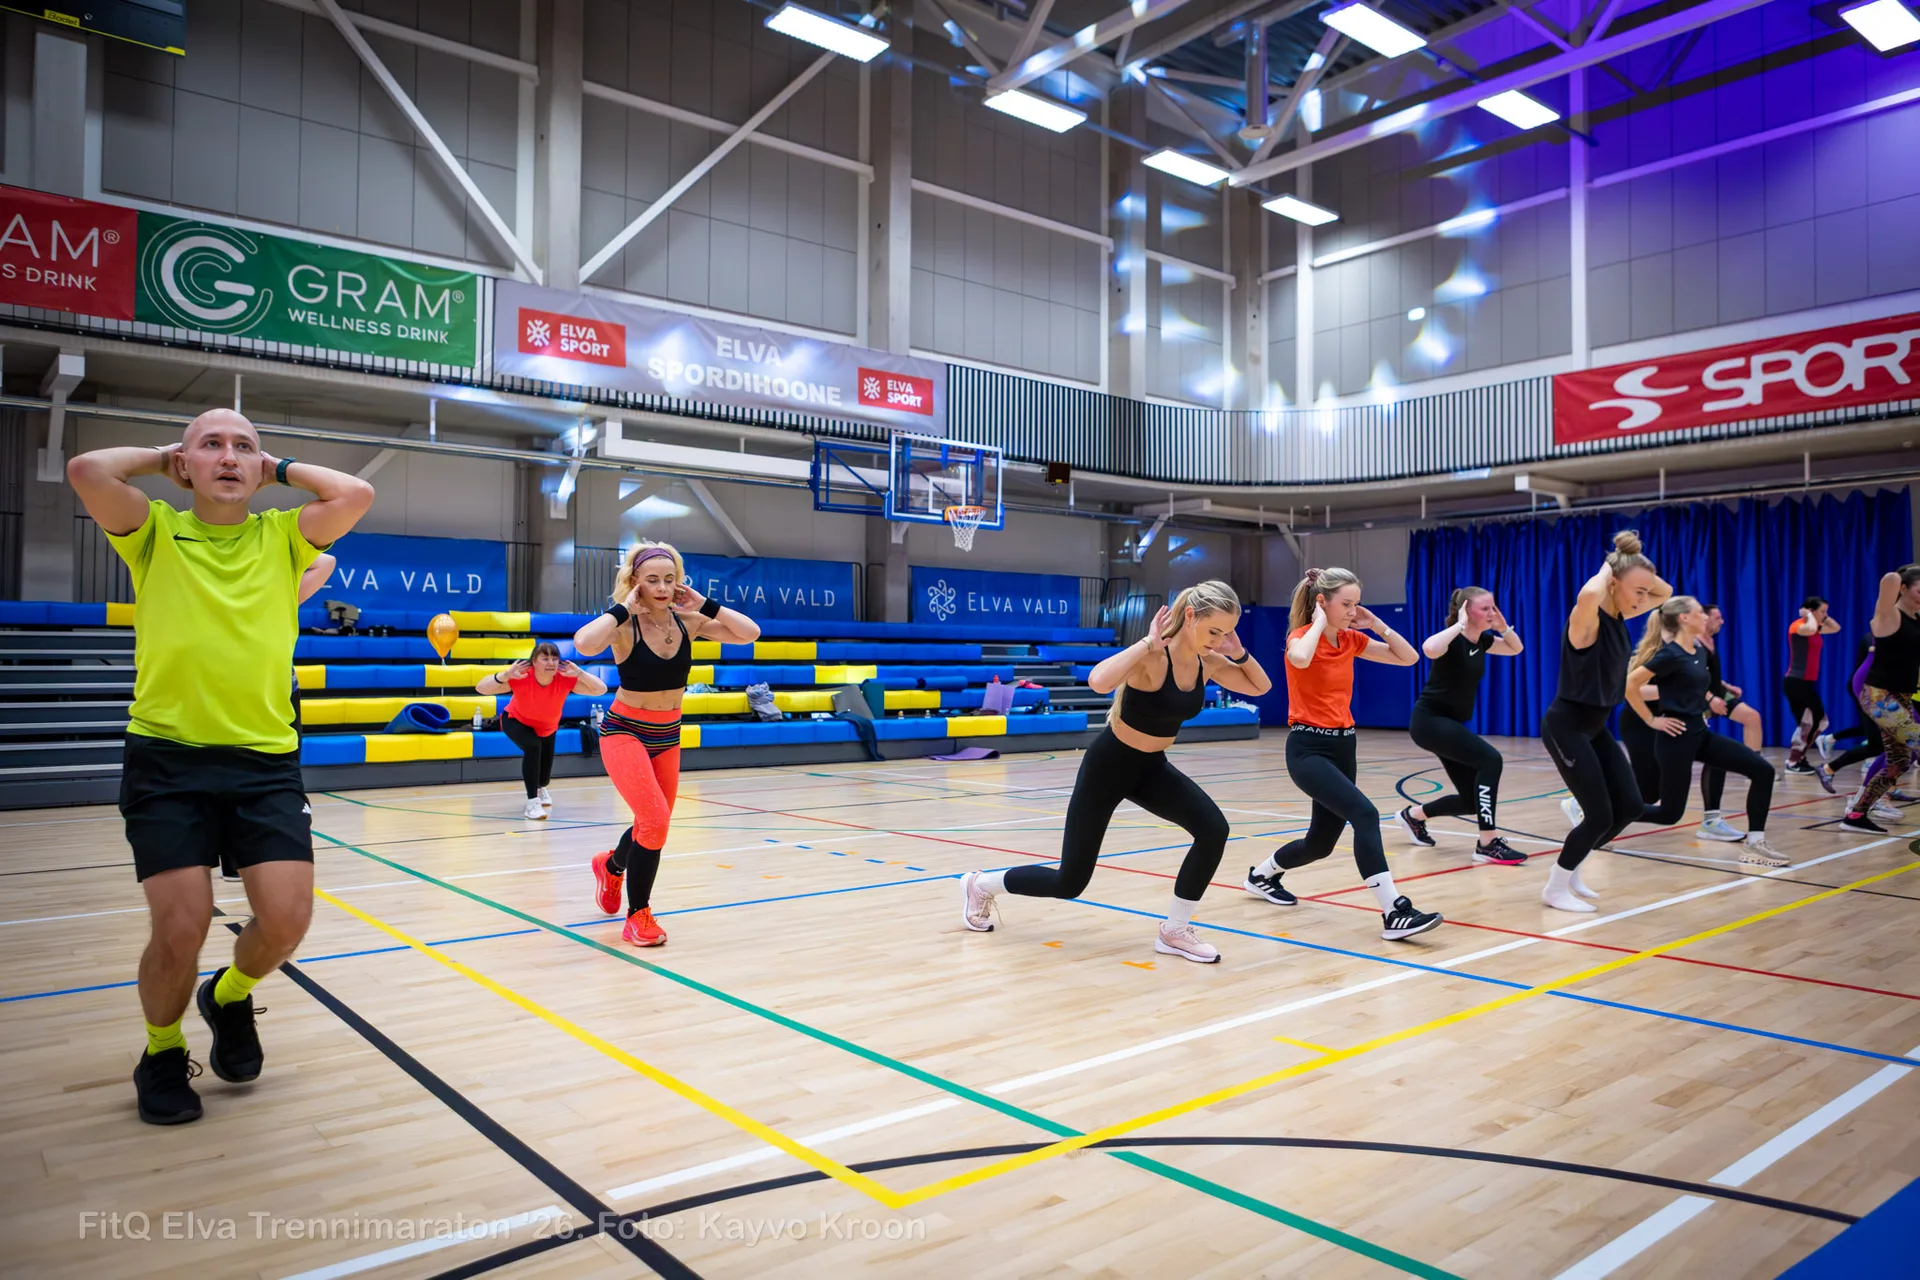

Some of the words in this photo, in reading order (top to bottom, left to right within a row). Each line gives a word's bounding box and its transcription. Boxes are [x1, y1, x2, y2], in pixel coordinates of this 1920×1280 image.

[26, 267, 97, 292] DRINK
[288, 308, 392, 336] WELLNESS
[397, 325, 449, 344] DRINK
[560, 323, 598, 341] ELVA
[560, 338, 610, 357] SPORT
[716, 335, 783, 367] ELVA
[648, 357, 843, 407] SPORDIHOONE
[1702, 328, 1920, 412] SPOR
[887, 379, 914, 394] ELVA
[887, 391, 922, 408] SPORT
[400, 570, 482, 594] VALD
[707, 578, 766, 604] ELVA
[779, 587, 835, 607] VALD
[967, 592, 1013, 613] ELVA
[1023, 598, 1068, 614] VALD
